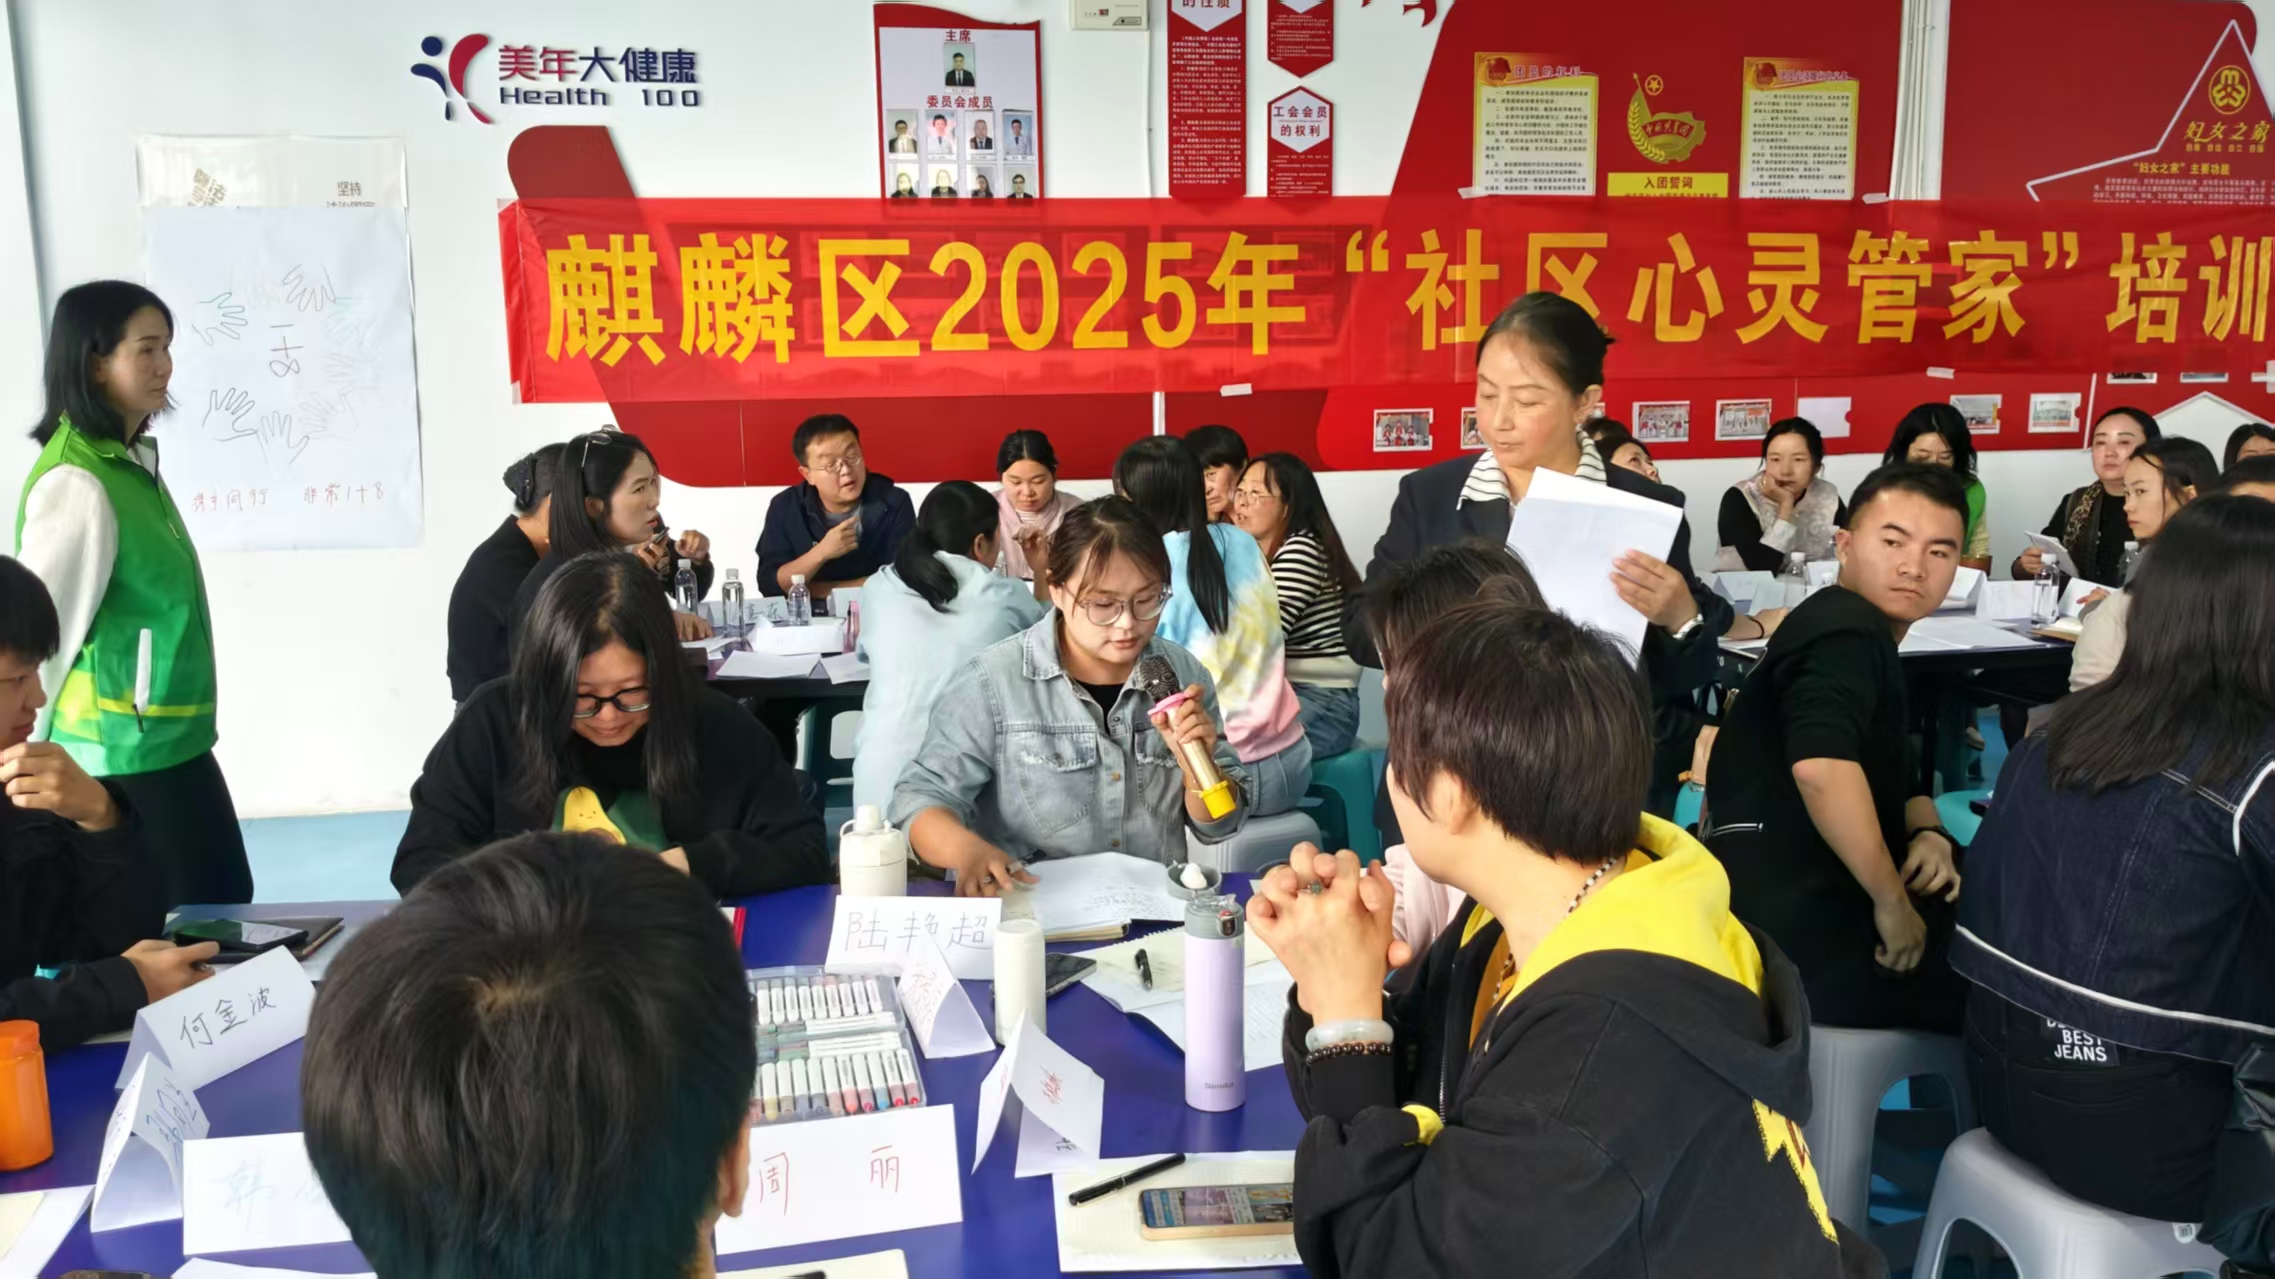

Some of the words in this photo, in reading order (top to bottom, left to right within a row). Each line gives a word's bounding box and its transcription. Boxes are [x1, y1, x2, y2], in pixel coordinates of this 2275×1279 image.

[945, 29, 972, 43] 主席
[499, 45, 698, 83] 美年大健康
[500, 87, 609, 107] Health
[642, 89, 699, 107] 100
[926, 95, 994, 109] 委员会成员
[1273, 105, 1327, 118] 工会会员
[1280, 124, 1320, 137] 的权利
[2183, 120, 2271, 144] 妇女之家
[336, 181, 362, 197] 坚持
[1643, 176, 1693, 189] 入团誓词
[844, 907, 994, 952] 陆艳超
[180, 986, 277, 1049] 何金波
[2054, 1044, 2108, 1062] JEANS
